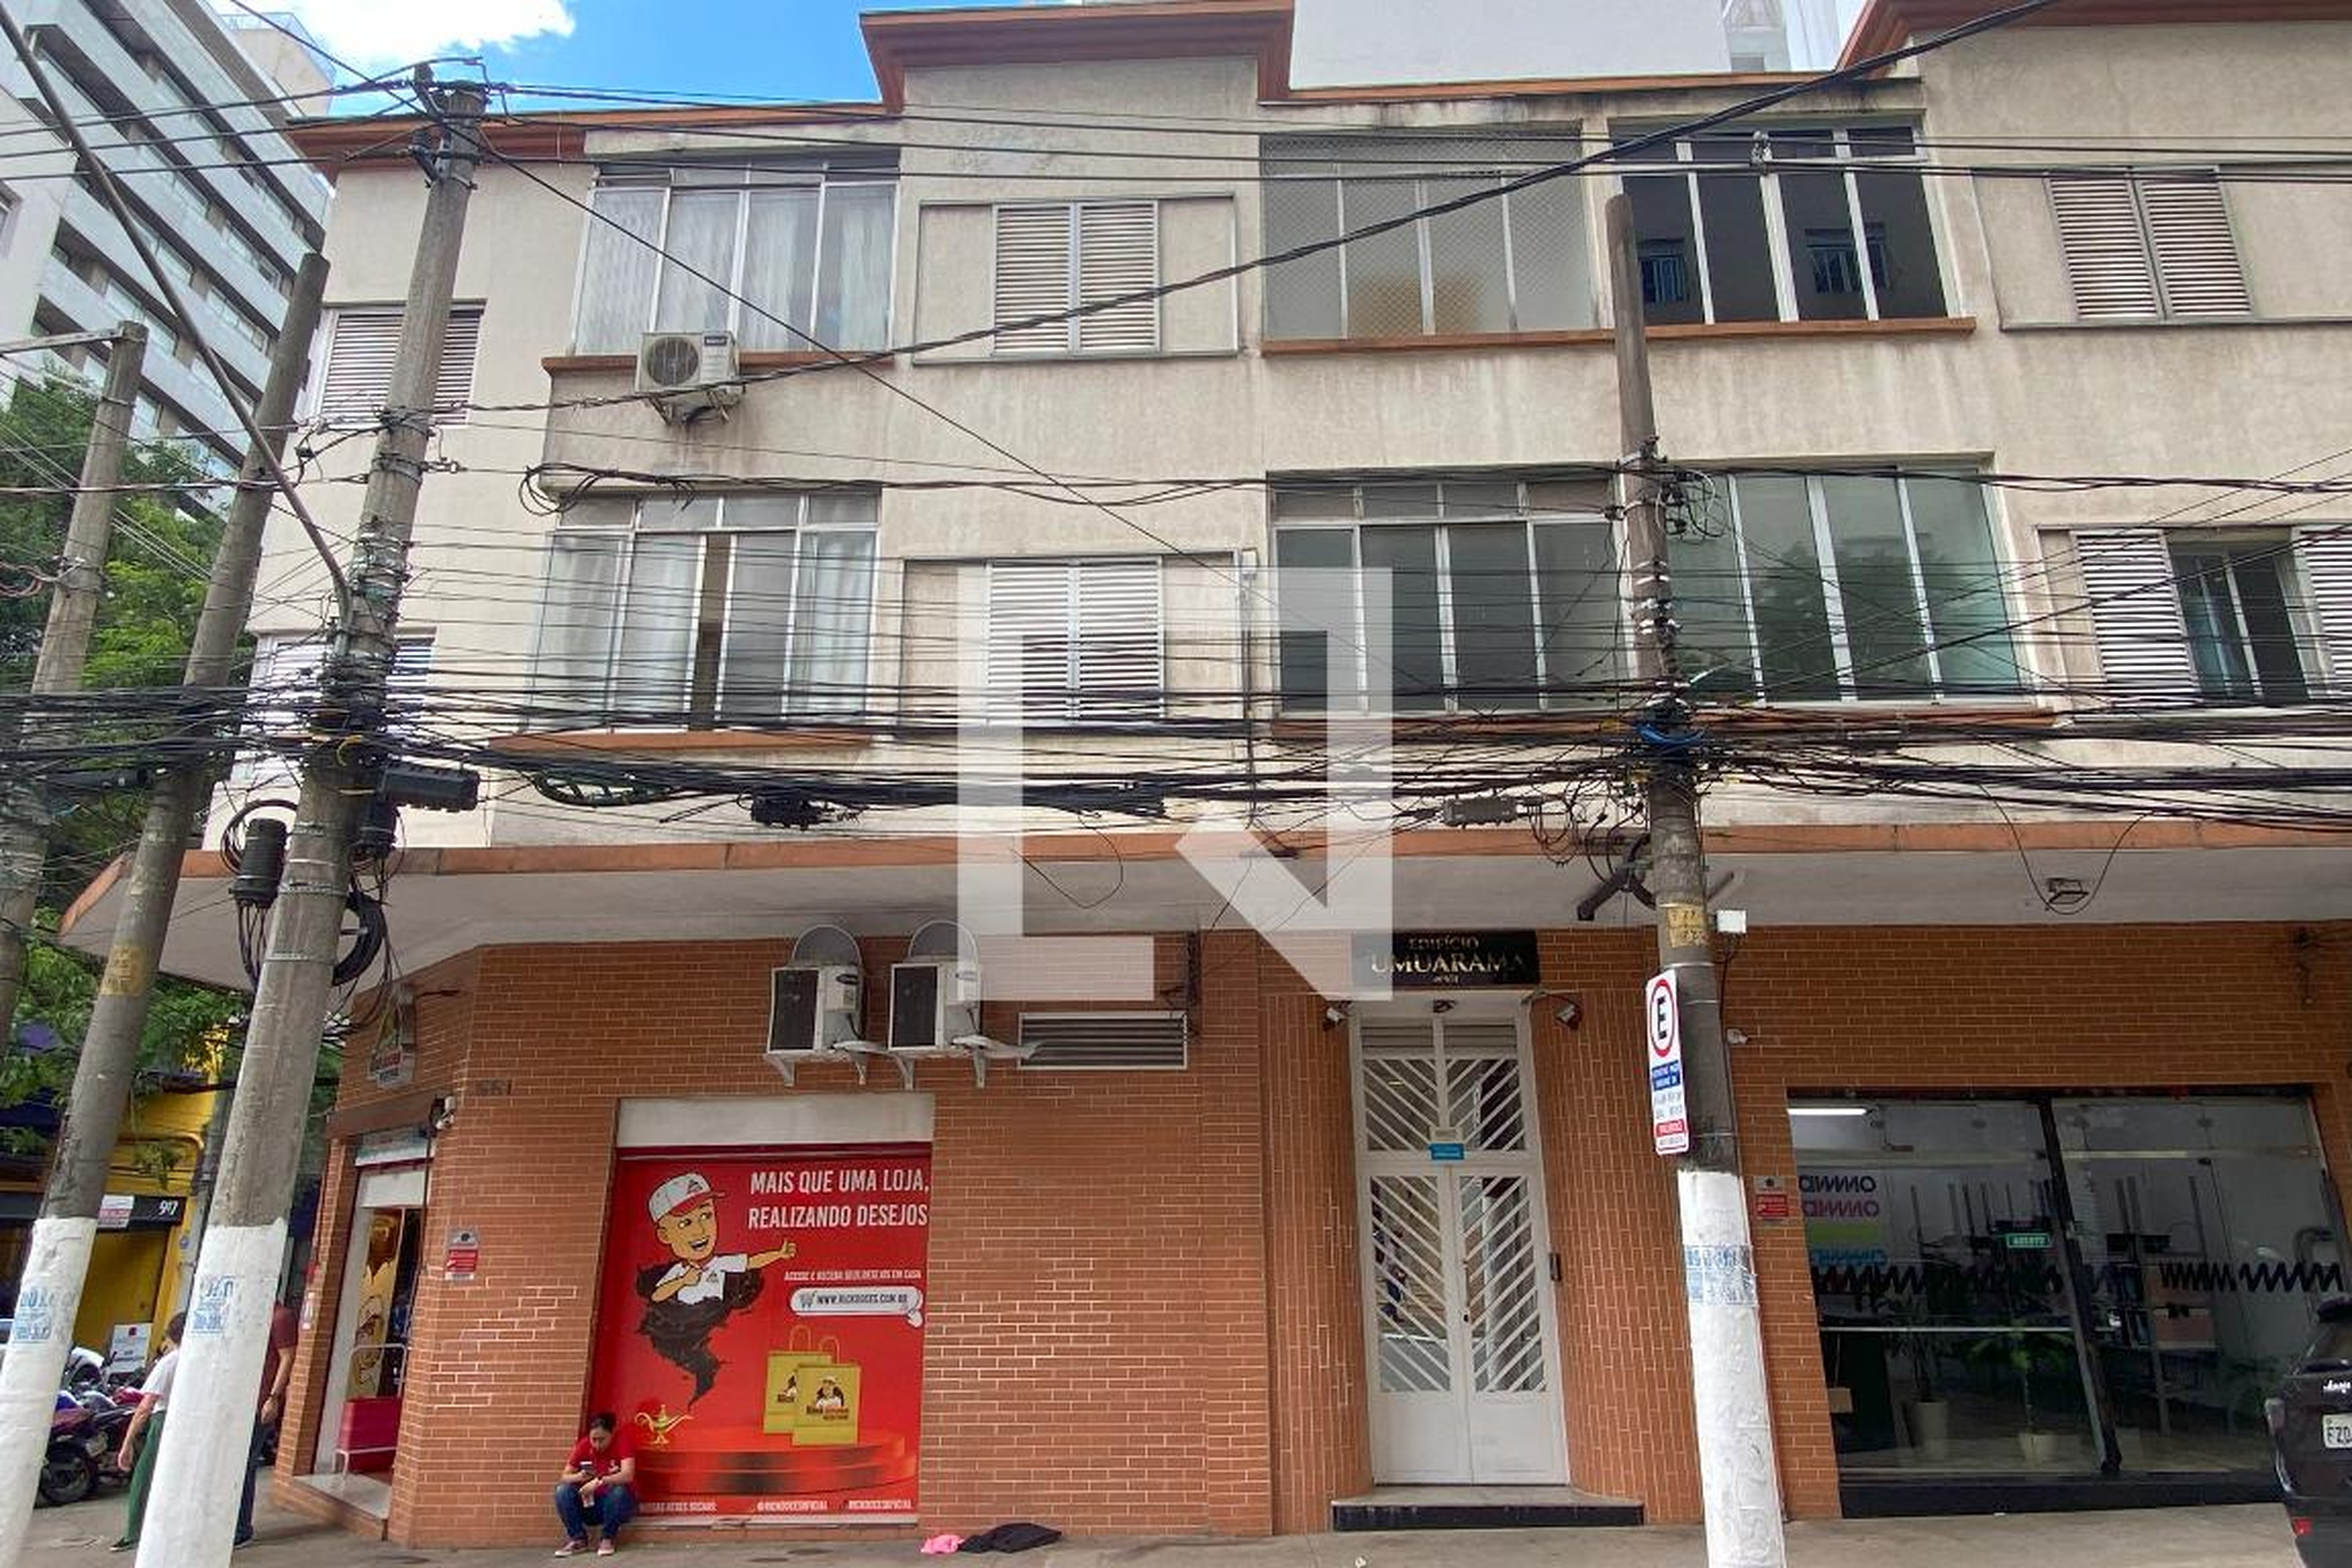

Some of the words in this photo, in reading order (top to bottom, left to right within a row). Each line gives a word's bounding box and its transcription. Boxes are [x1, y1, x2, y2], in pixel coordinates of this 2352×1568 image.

[1656, 996, 1668, 1039] E
[751, 1171, 794, 1194] MAIS
[799, 1170, 834, 1193] QUE
[839, 1169, 877, 1192] UMA
[883, 1169, 930, 1193] LOJA,
[748, 1205, 851, 1229] REALIZANDO
[857, 1204, 929, 1226] DESEJOS
